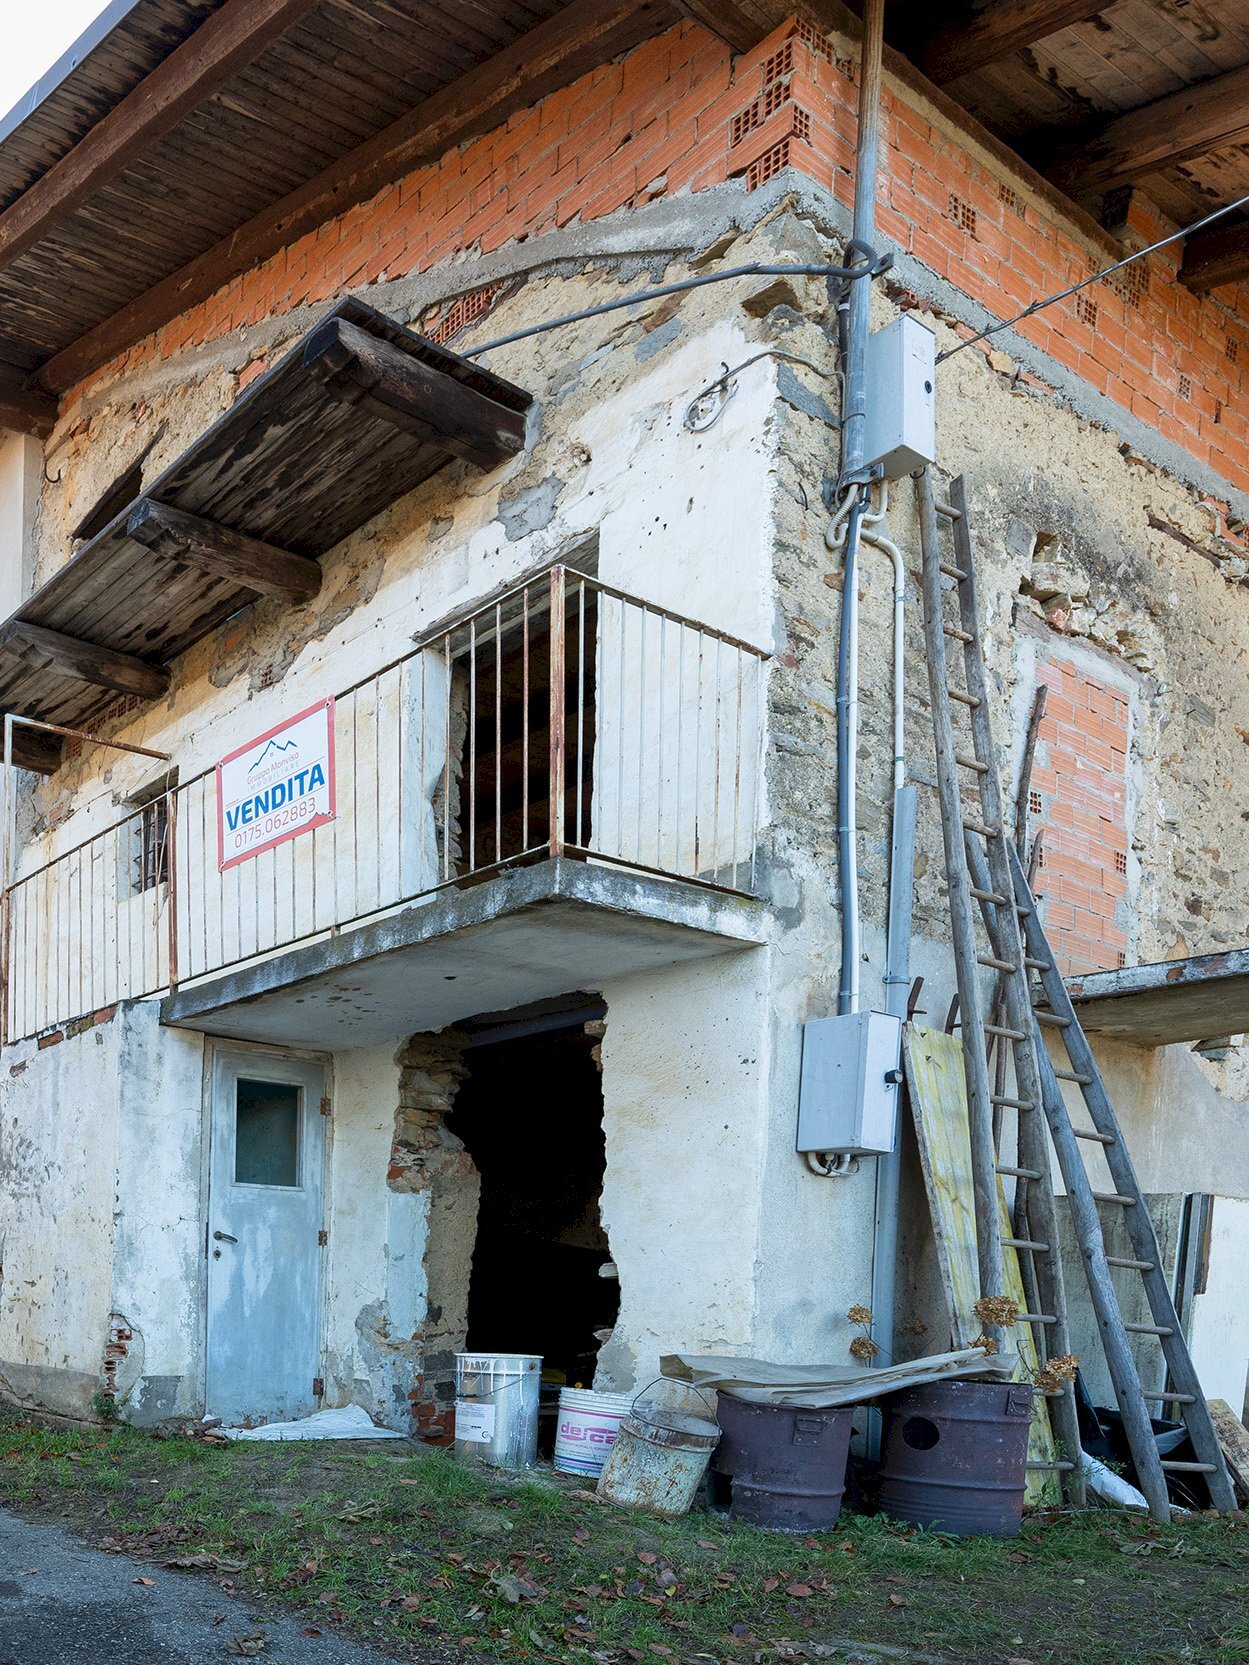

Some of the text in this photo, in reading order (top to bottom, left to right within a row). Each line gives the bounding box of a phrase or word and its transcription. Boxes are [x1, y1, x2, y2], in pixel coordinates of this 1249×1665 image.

[247, 752, 299, 785] Gruppo Monviso
[226, 763, 325, 831] VENDITA
[234, 797, 316, 848] 0175.062883
